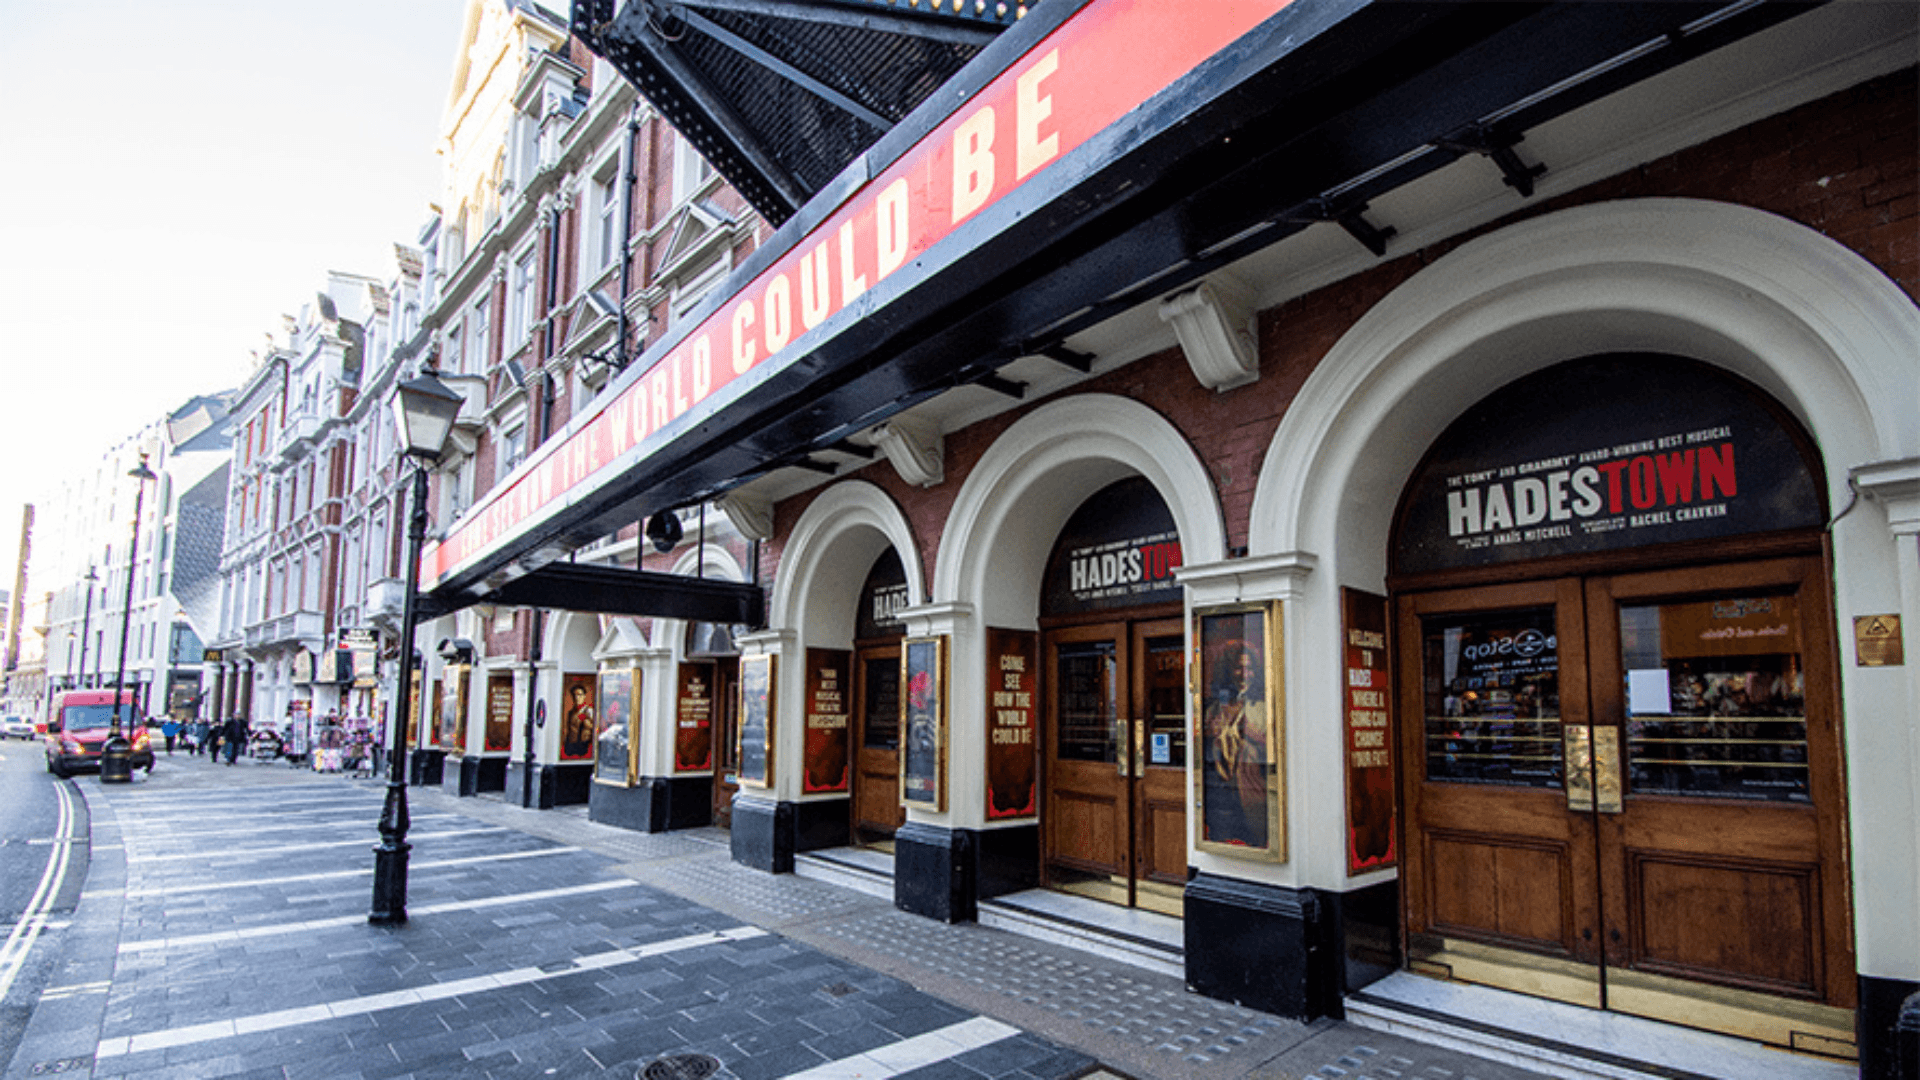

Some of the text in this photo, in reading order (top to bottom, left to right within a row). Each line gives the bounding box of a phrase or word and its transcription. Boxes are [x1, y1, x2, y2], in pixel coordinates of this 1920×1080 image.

[564, 421, 599, 490] THE
[609, 332, 712, 455] WORLD
[732, 176, 909, 374] COULD
[951, 47, 1060, 225] BE
[1658, 433, 1683, 450] BEST
[1686, 425, 1732, 444] MUSICAL
[1447, 442, 1738, 537] HADESTOWN
[1630, 510, 1673, 528] RACHEL
[1675, 503, 1728, 522] CHAVKIN
[1004, 673, 1022, 690] SEE
